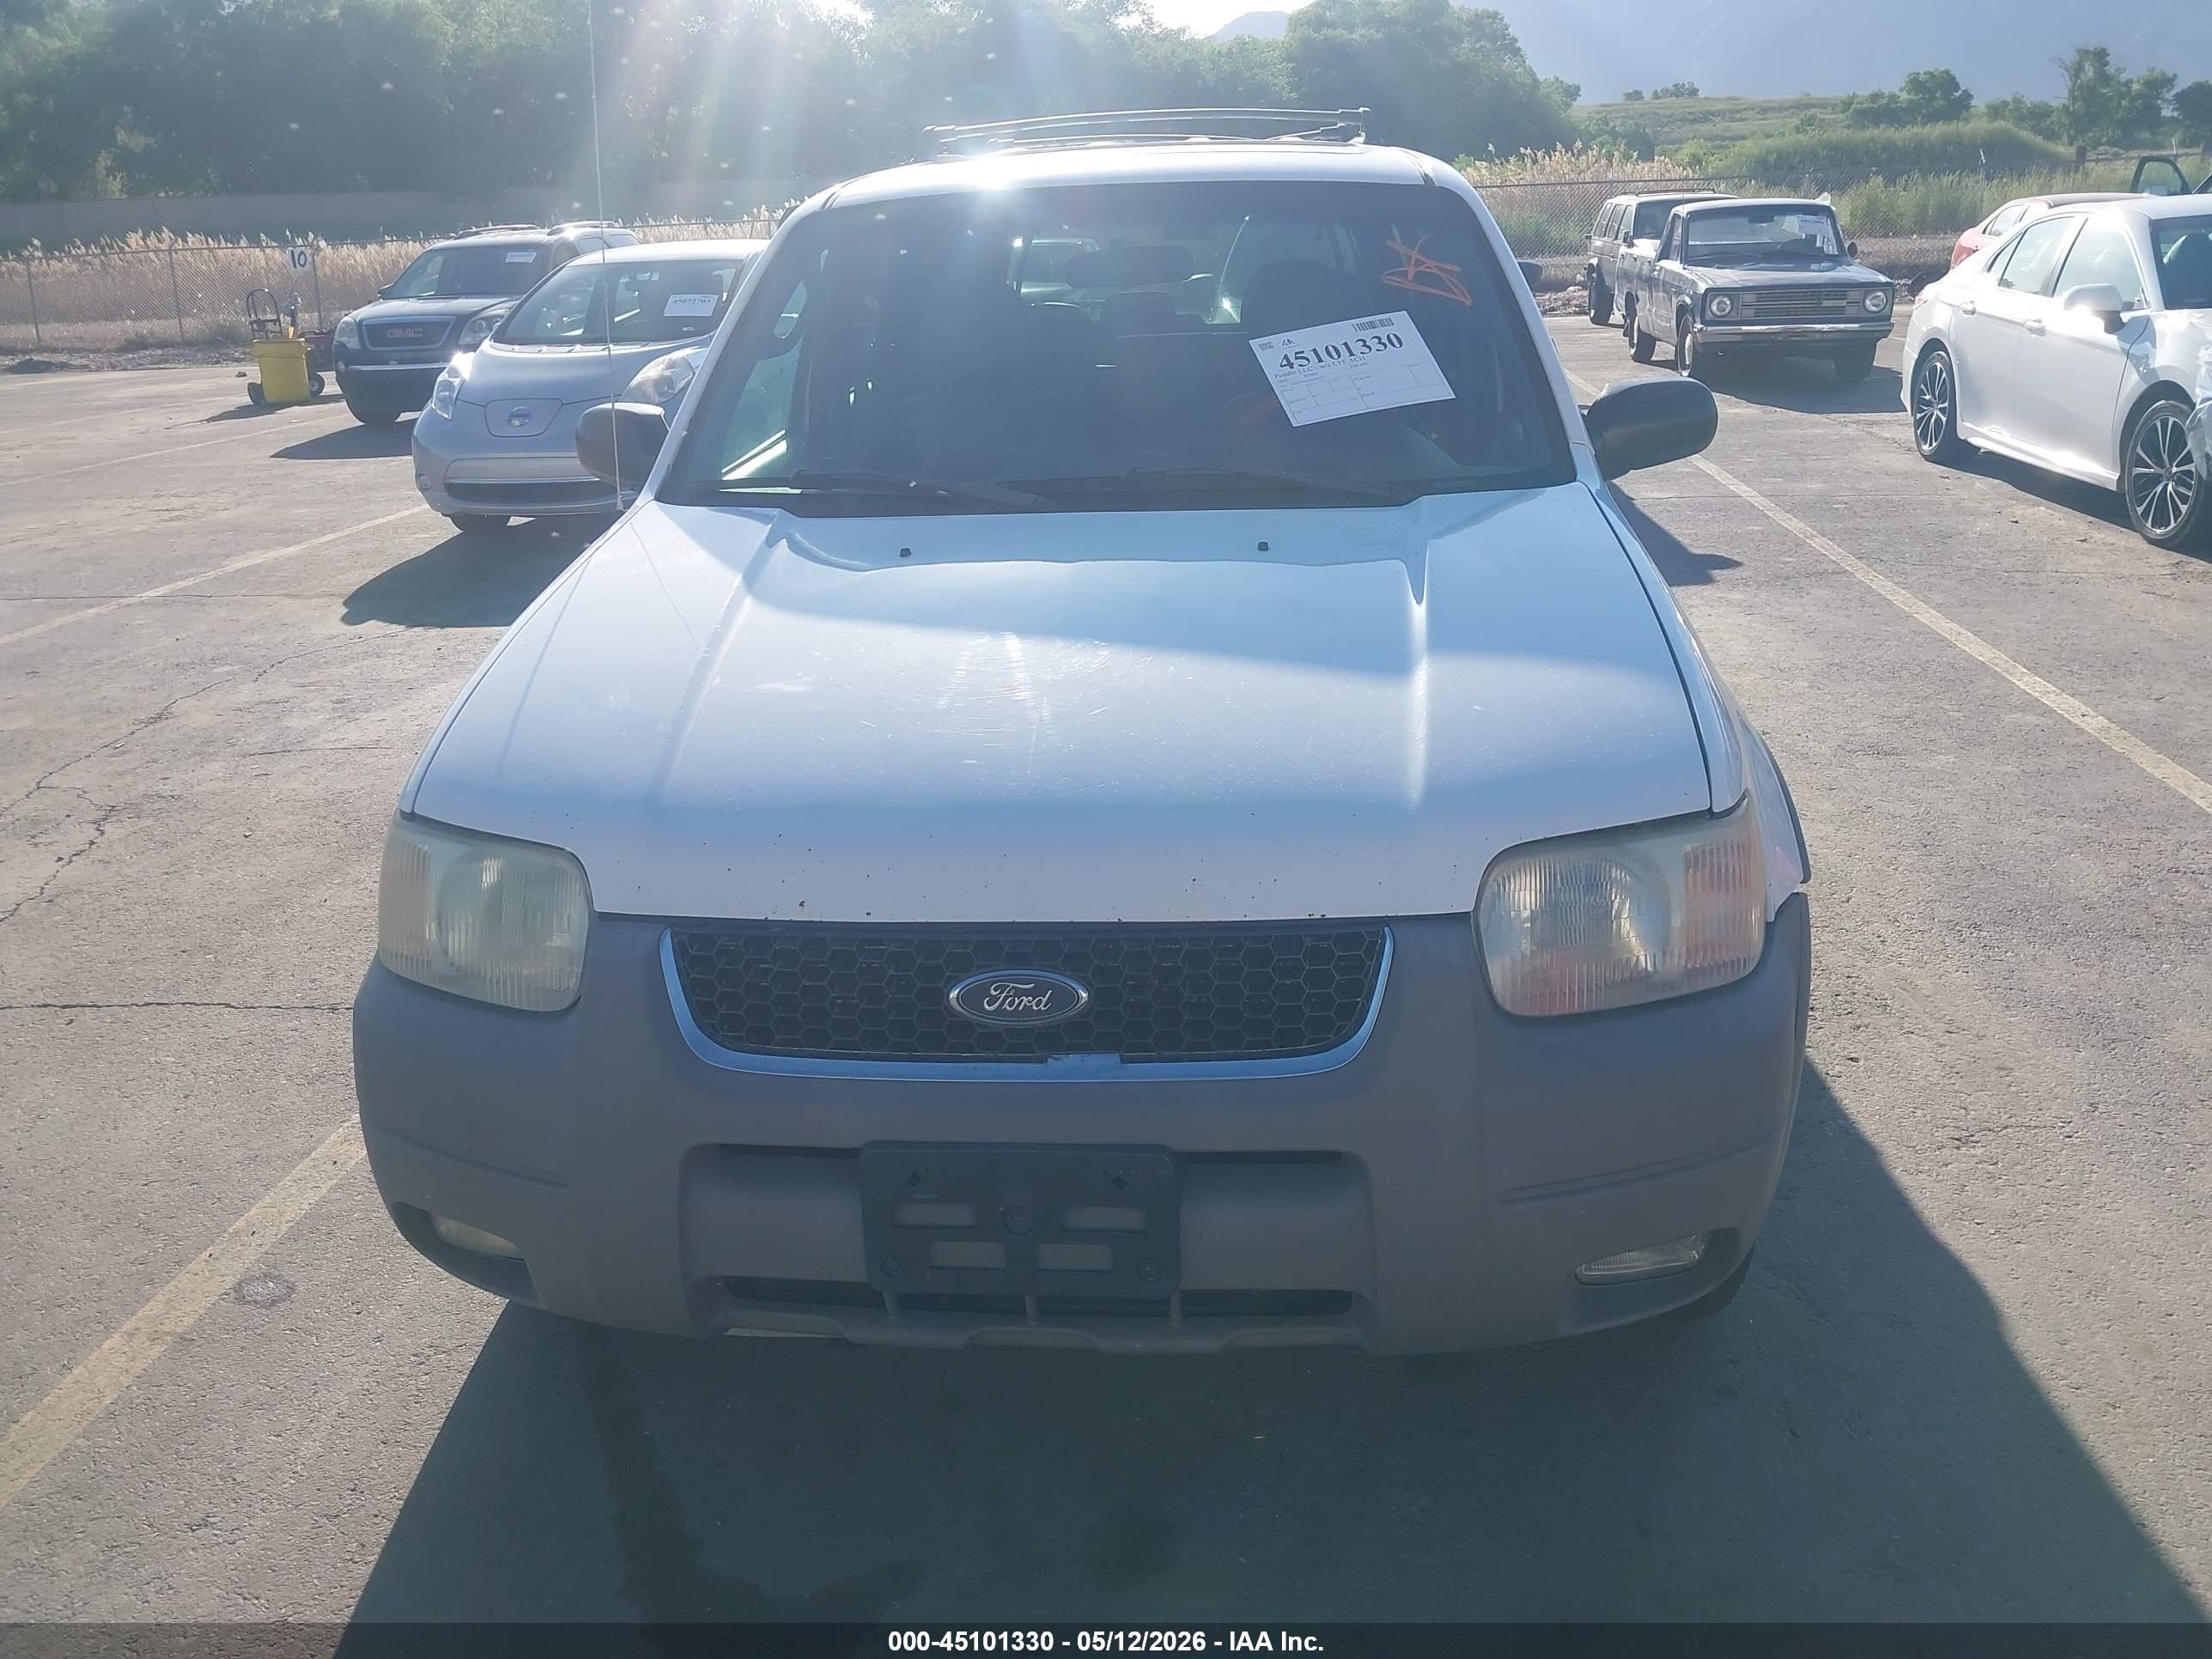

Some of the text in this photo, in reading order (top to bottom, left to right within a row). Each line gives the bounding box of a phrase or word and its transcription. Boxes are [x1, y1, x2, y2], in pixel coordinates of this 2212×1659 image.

[290, 249, 307, 269] 10
[386, 329, 422, 338] GMC
[1279, 332, 1404, 369] 45101330
[983, 981, 1053, 1012] Ford
